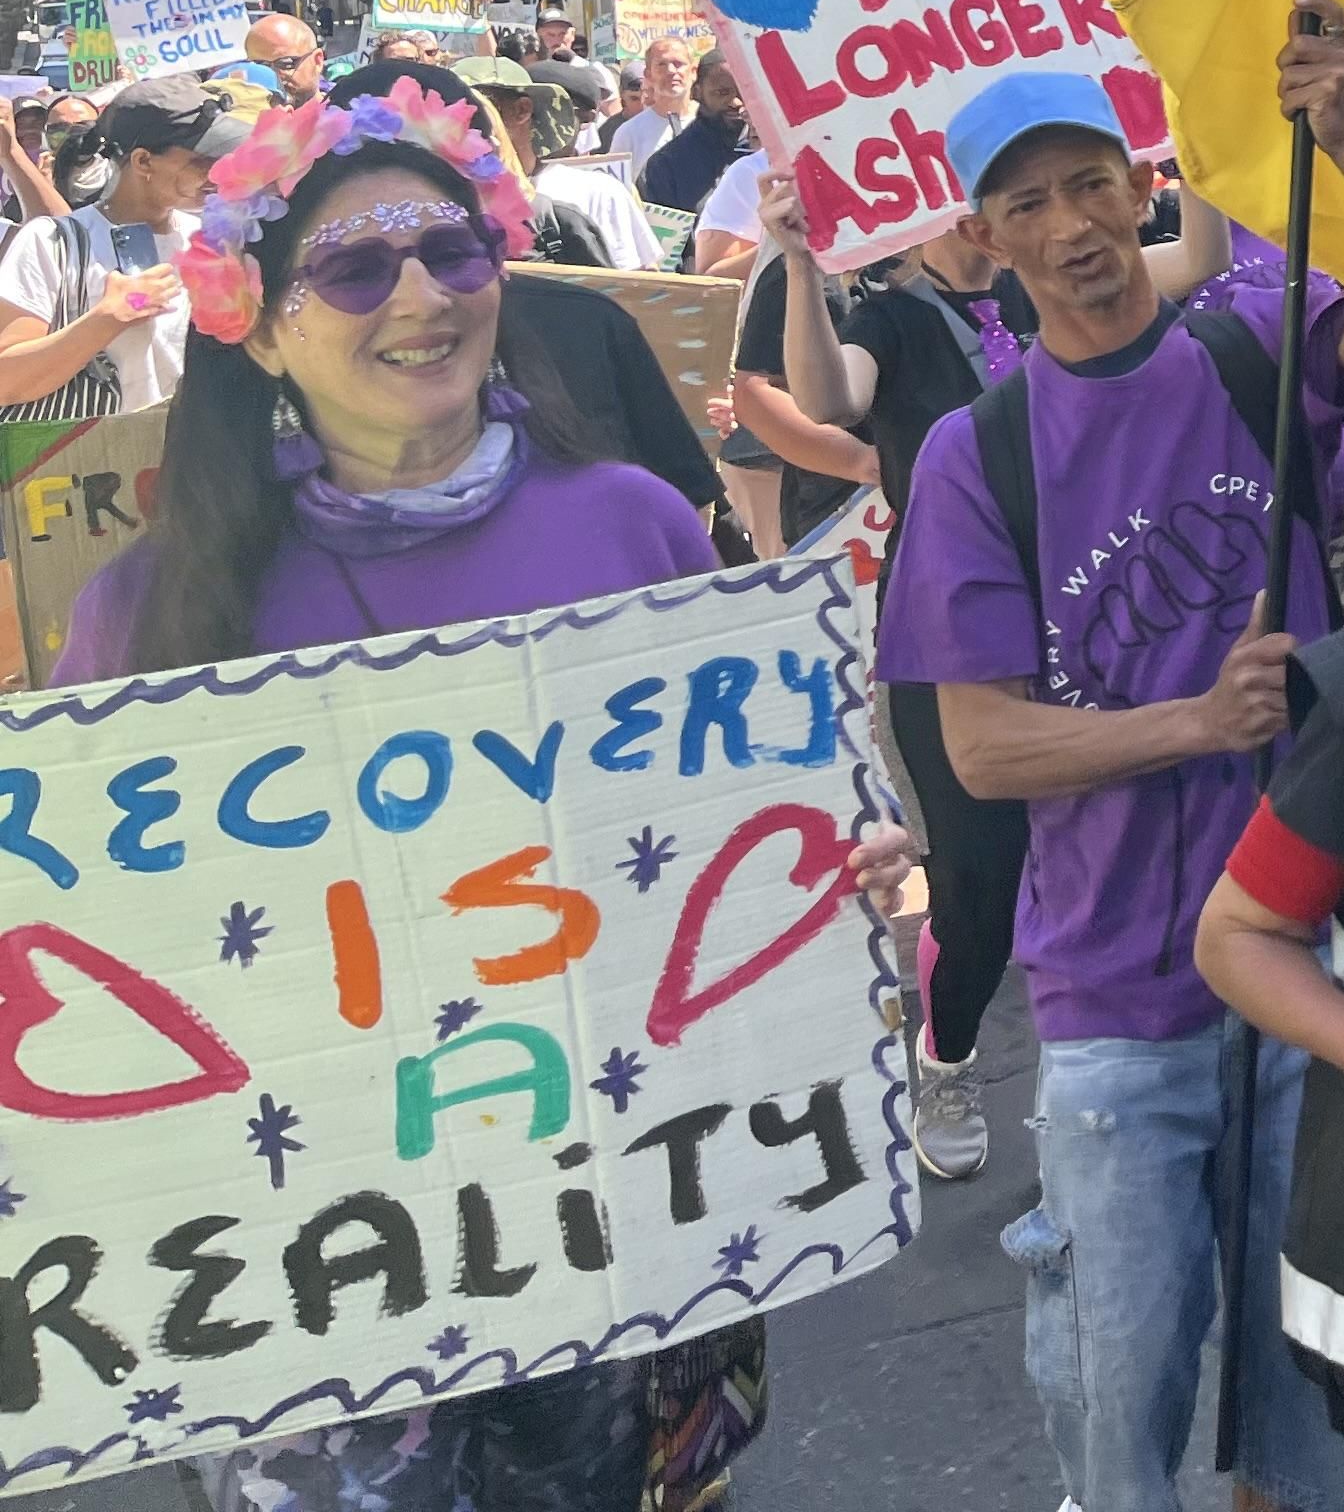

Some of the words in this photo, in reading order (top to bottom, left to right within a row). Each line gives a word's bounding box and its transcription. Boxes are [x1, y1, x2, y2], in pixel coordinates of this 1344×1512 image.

[131, 17, 174, 38] THE
[191, 10, 213, 26] IN
[216, 3, 245, 20] MY
[158, 29, 234, 63] SOUL
[1216, 256, 1265, 282] WALK
[1061, 507, 1151, 597] WALK
[0, 649, 838, 889] RECOVERY
[326, 845, 601, 1029] IS
[394, 1021, 571, 1161] A
